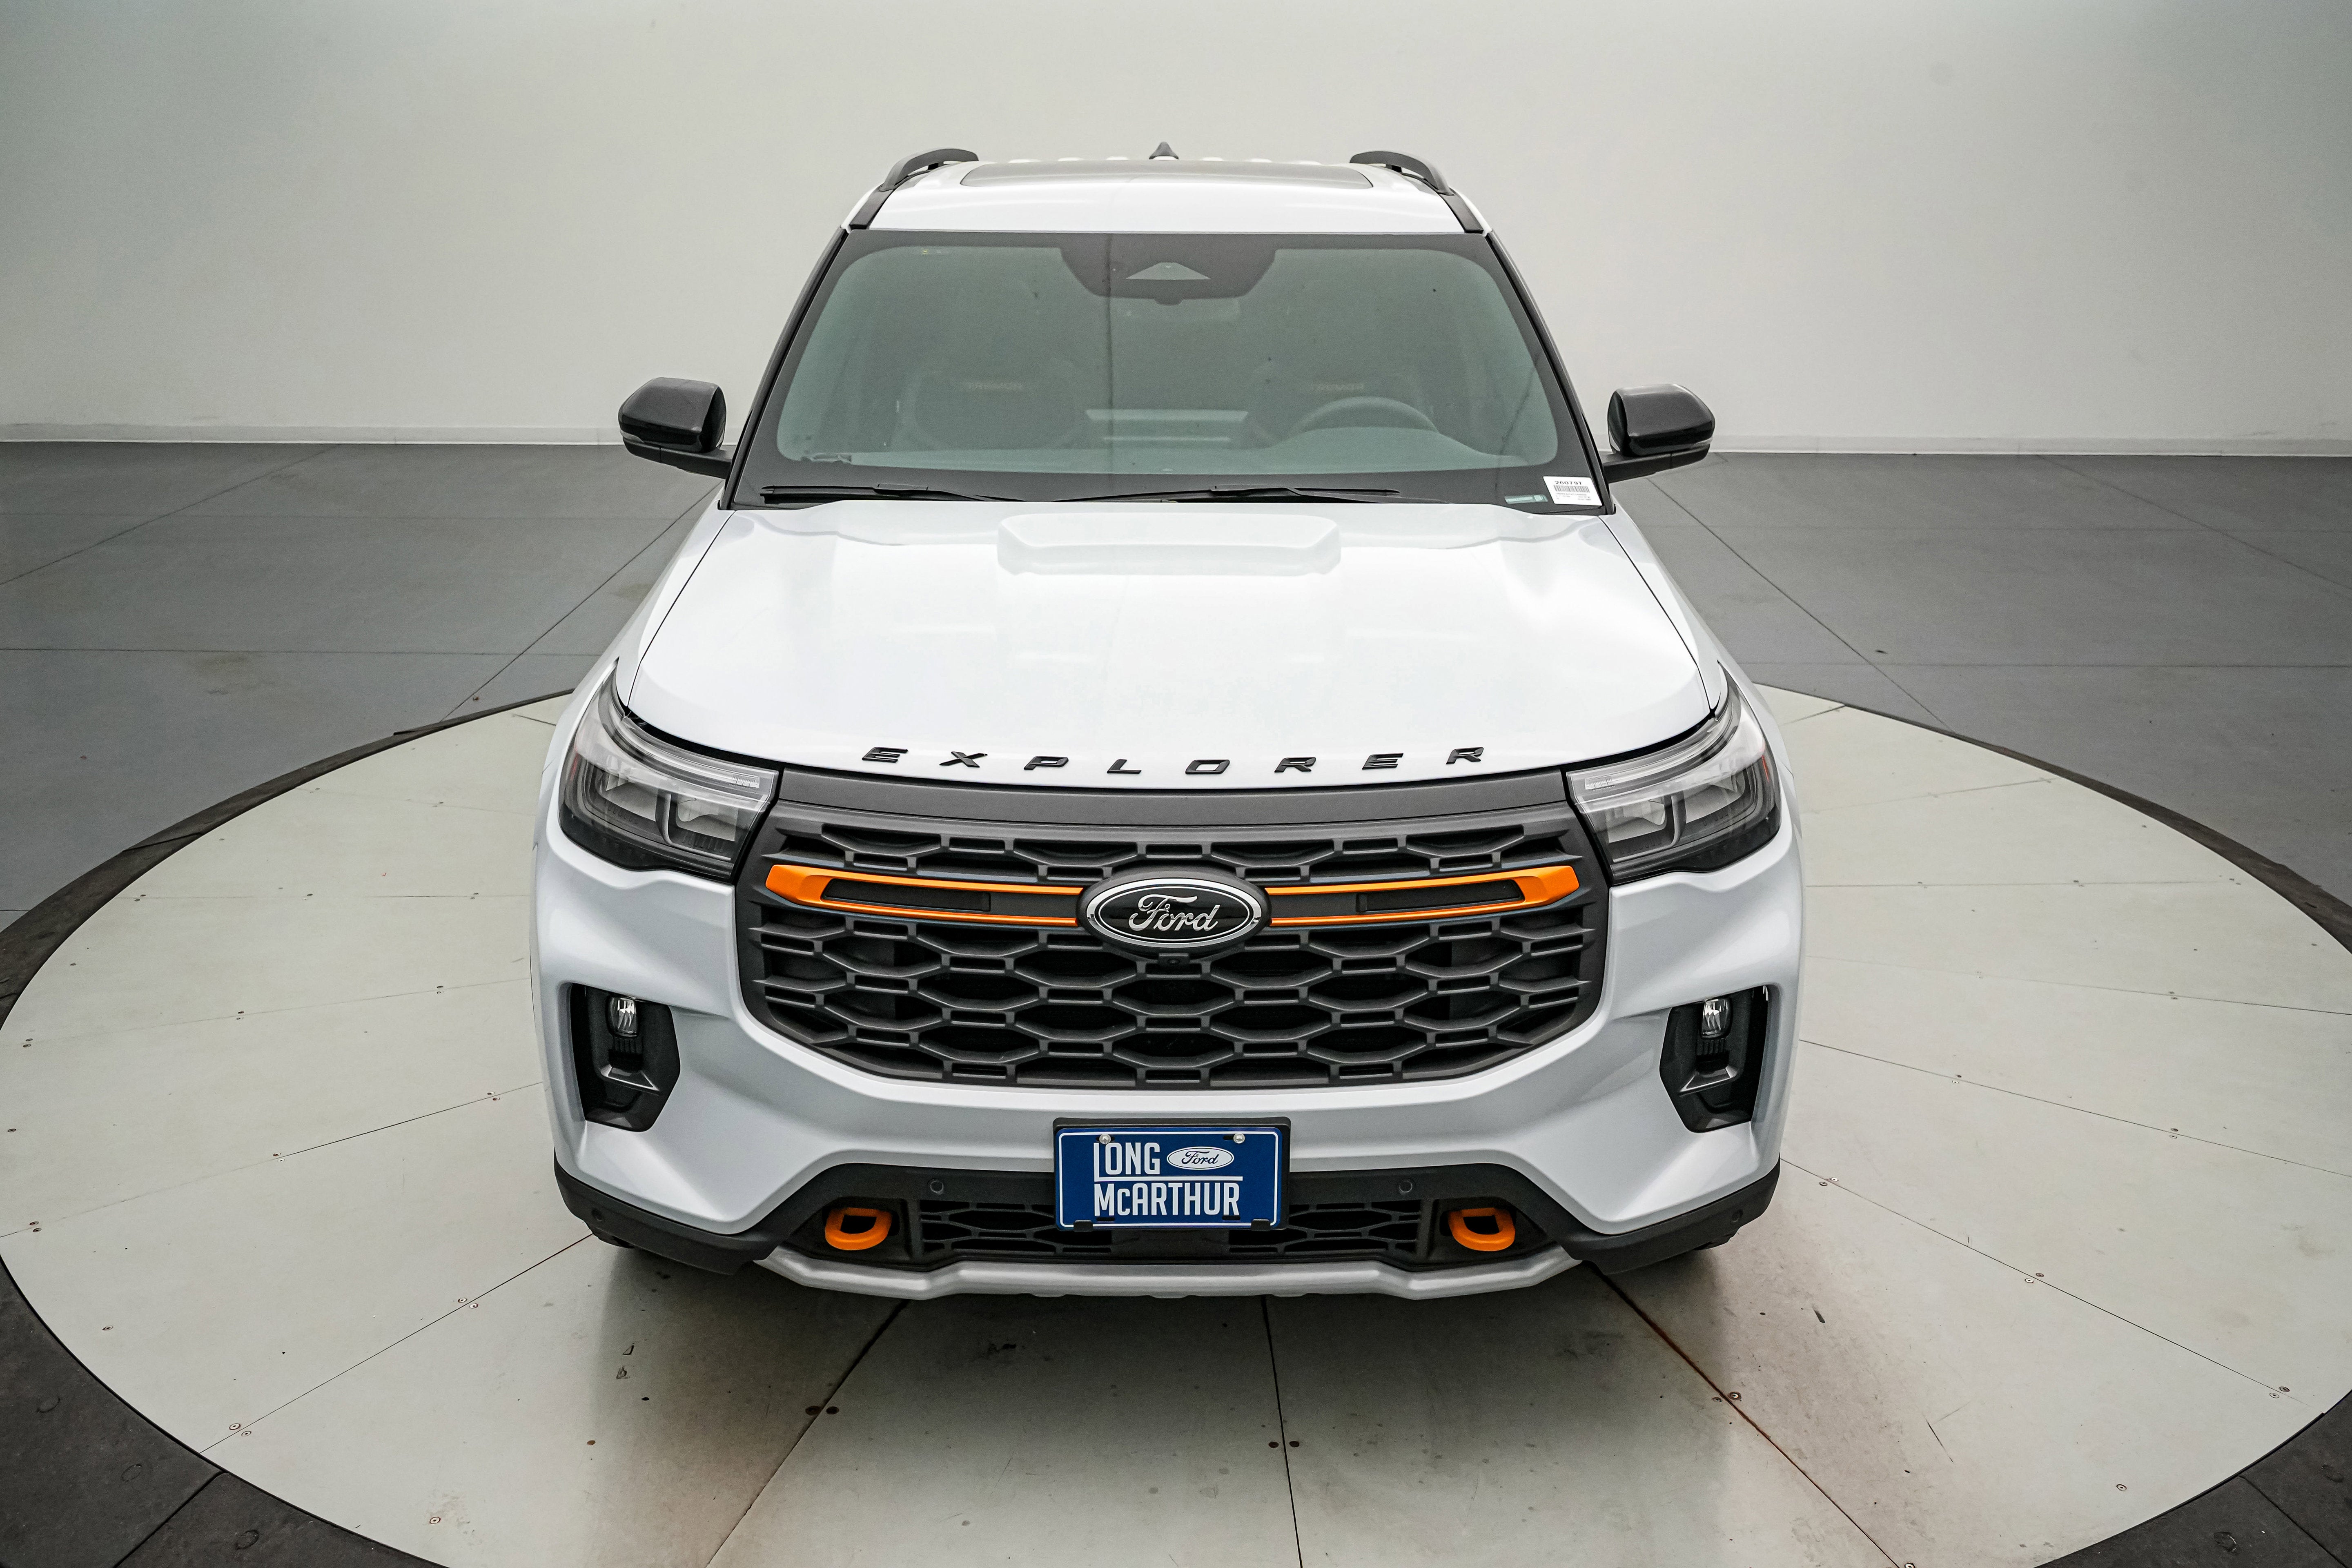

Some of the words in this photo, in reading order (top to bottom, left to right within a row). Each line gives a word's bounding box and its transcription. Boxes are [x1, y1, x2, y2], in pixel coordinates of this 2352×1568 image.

[862, 746, 1484, 775] EXPLORER
[1128, 893, 1221, 931] Ford
[1094, 1142, 1160, 1180] LONG
[1181, 1150, 1220, 1164] Ford
[1094, 1183, 1239, 1216] McARTHUR
